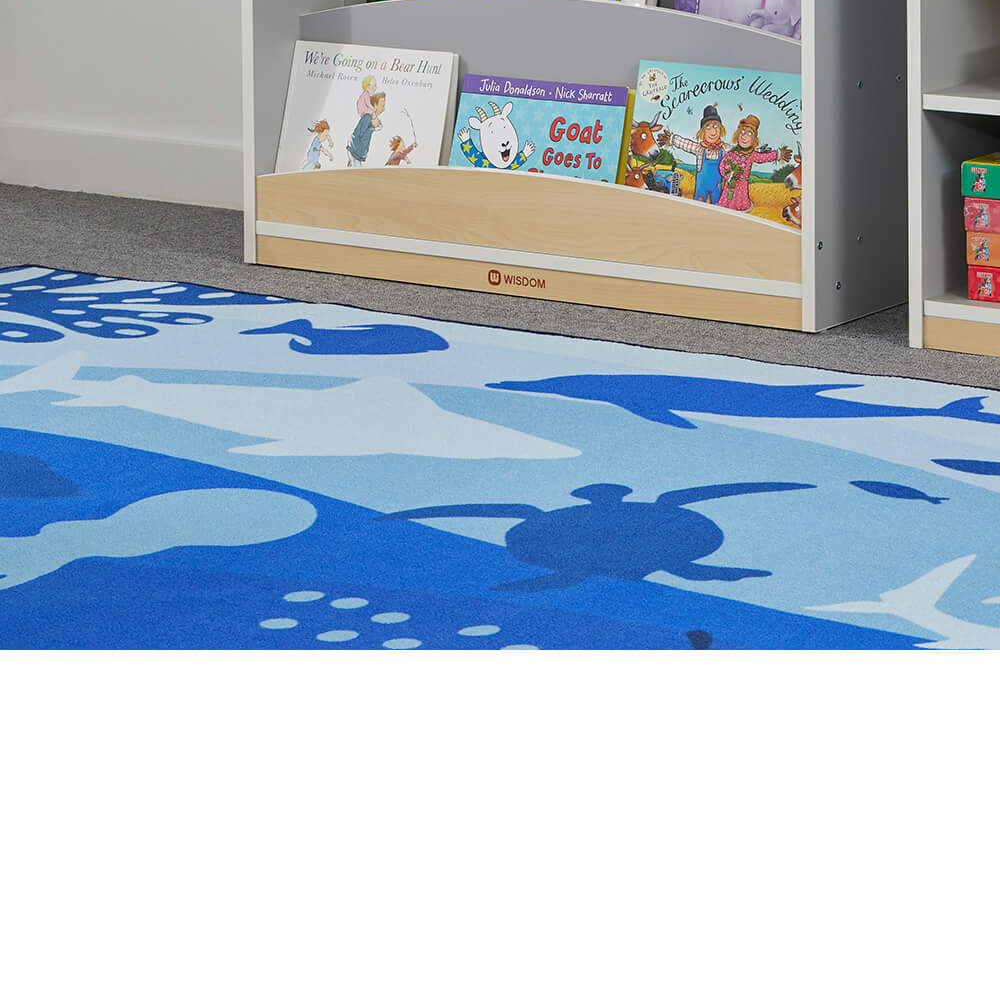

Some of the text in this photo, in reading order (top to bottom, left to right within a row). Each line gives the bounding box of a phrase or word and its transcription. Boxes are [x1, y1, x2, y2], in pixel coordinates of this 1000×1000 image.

[304, 51, 442, 75] We're Going on a Bear Hunt
[306, 70, 335, 80] Michael
[670, 73, 689, 92] The
[480, 79, 545, 96] Julia Donaldson
[555, 87, 613, 102] Nick Sharratt
[660, 76, 745, 120] Scarecrows'
[748, 76, 802, 136] Wedding
[550, 116, 603, 144] Goat
[543, 147, 602, 169] Goes To
[504, 274, 546, 288] WISDOM
